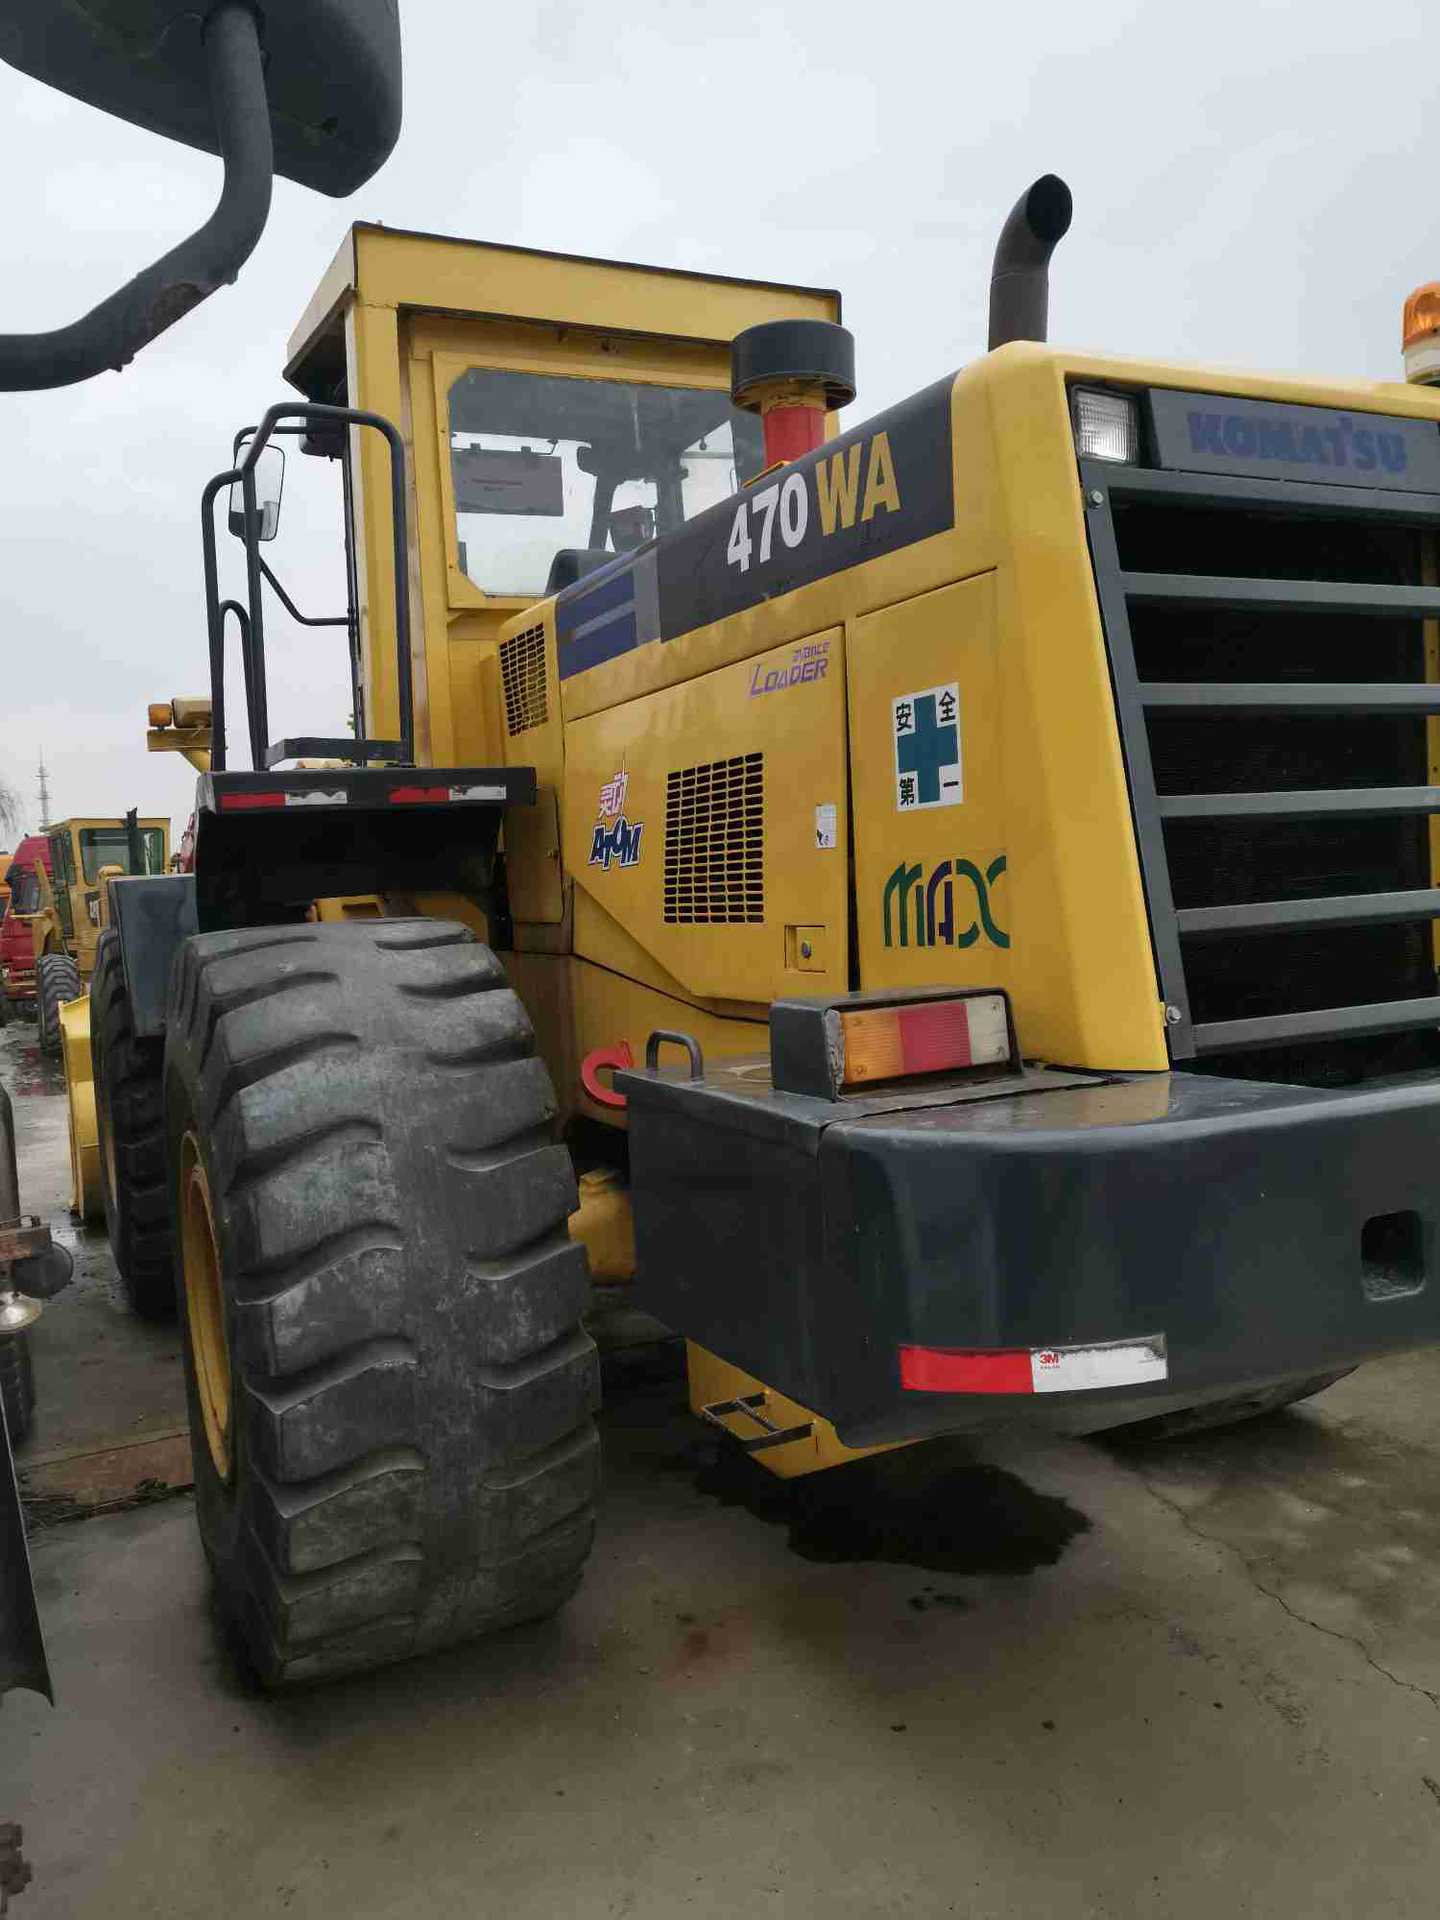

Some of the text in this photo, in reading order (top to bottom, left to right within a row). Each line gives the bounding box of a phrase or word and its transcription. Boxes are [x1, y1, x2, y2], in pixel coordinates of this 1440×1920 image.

[1187, 411, 1408, 473] KOMATSU
[727, 431, 901, 573] 470 WA
[1039, 1352, 1060, 1365] 3M
